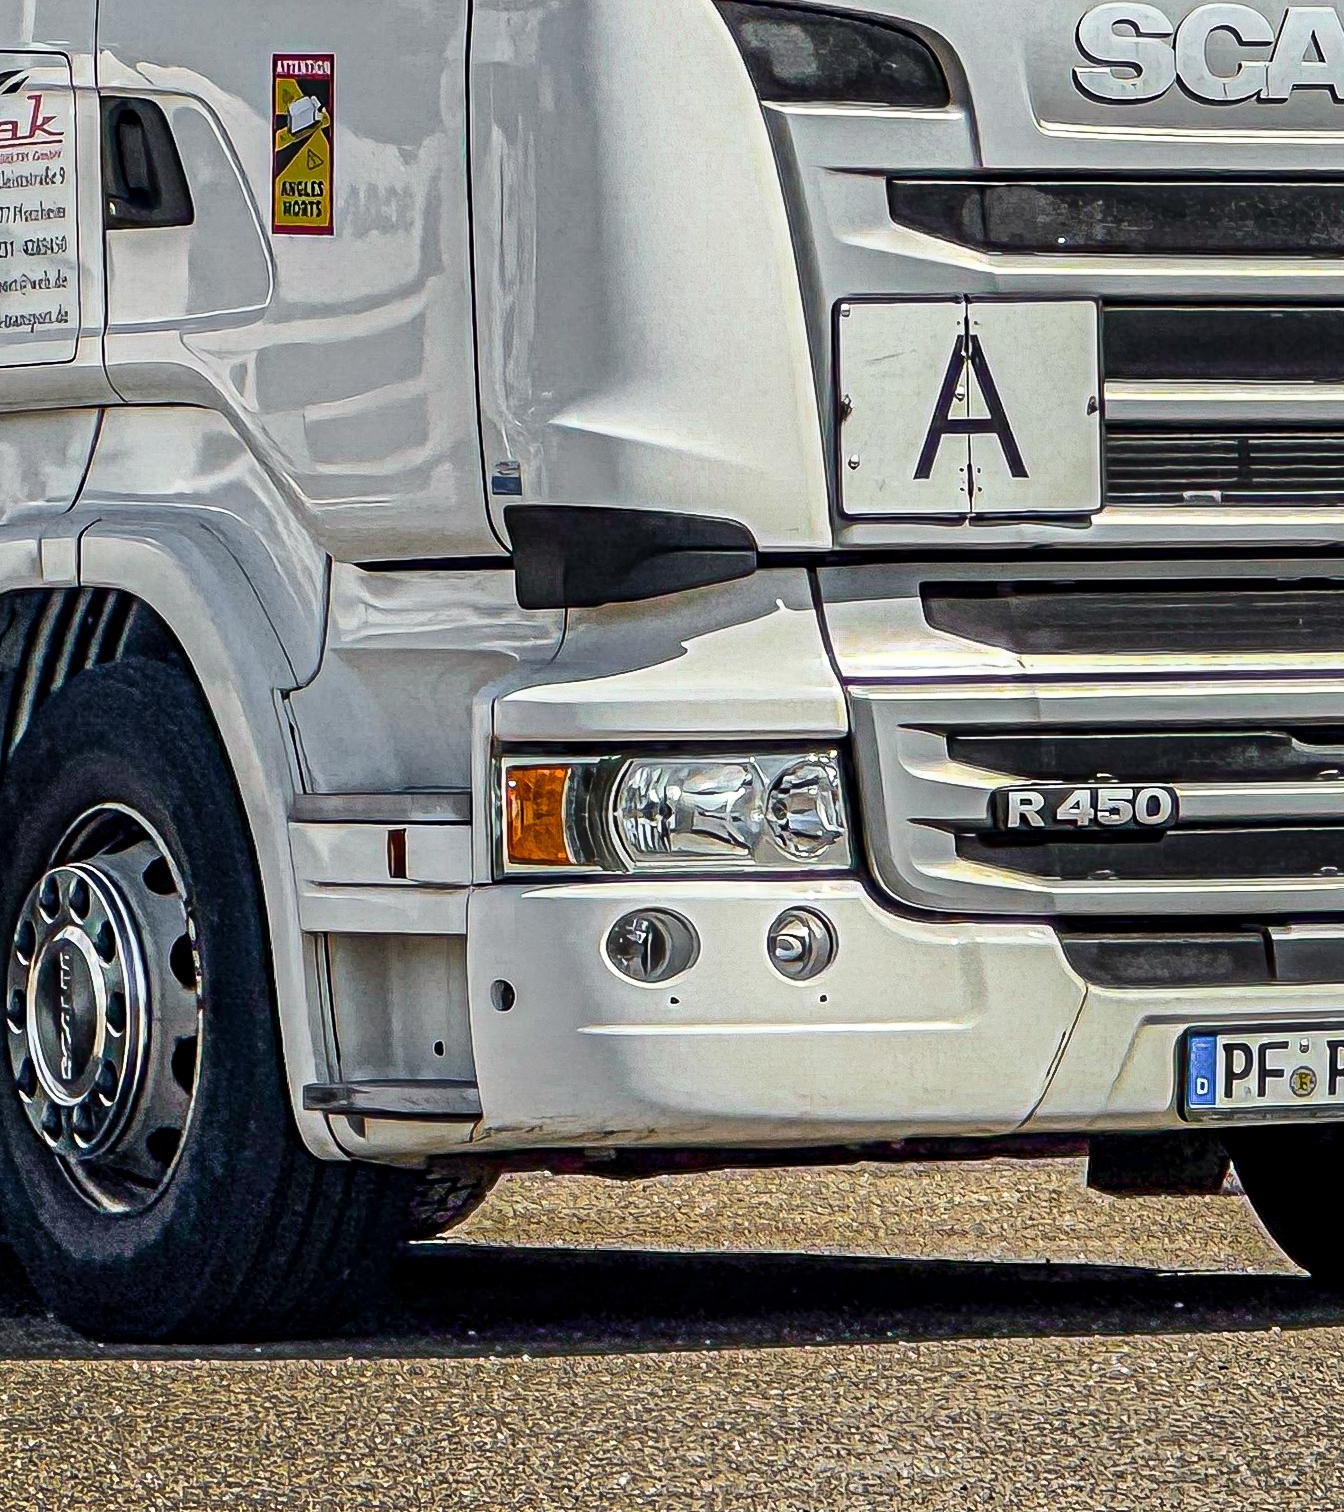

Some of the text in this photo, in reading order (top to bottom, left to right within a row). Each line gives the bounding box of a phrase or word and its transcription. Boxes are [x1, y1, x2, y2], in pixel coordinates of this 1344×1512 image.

[281, 180, 324, 198] ANGLES
[912, 334, 1030, 480] A
[1007, 787, 1173, 828] R 450
[1221, 1040, 1290, 1099] PF
